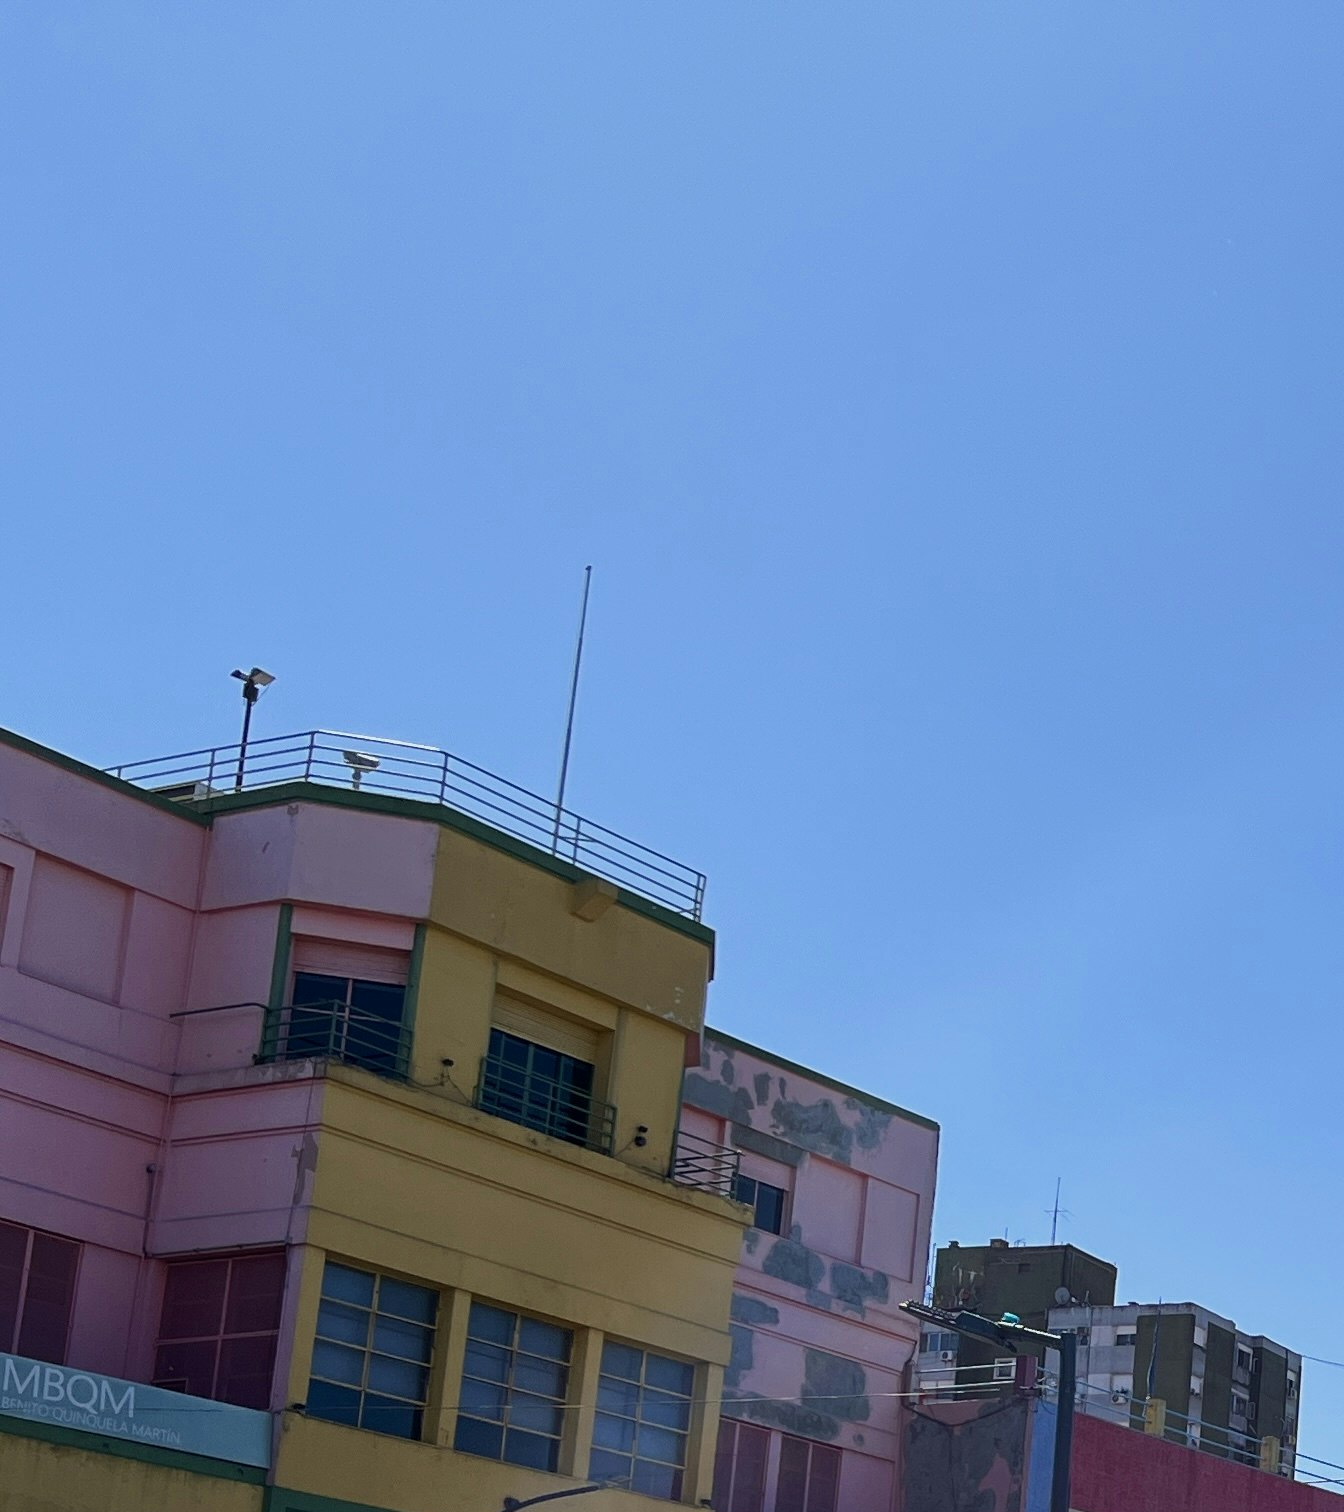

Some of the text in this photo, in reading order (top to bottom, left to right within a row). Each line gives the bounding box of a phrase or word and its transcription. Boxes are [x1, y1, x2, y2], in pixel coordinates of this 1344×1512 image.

[3, 1360, 135, 1417] MBQM
[52, 1406, 128, 1434] QUINQUELA
[132, 1422, 181, 1444] MARTÍN
